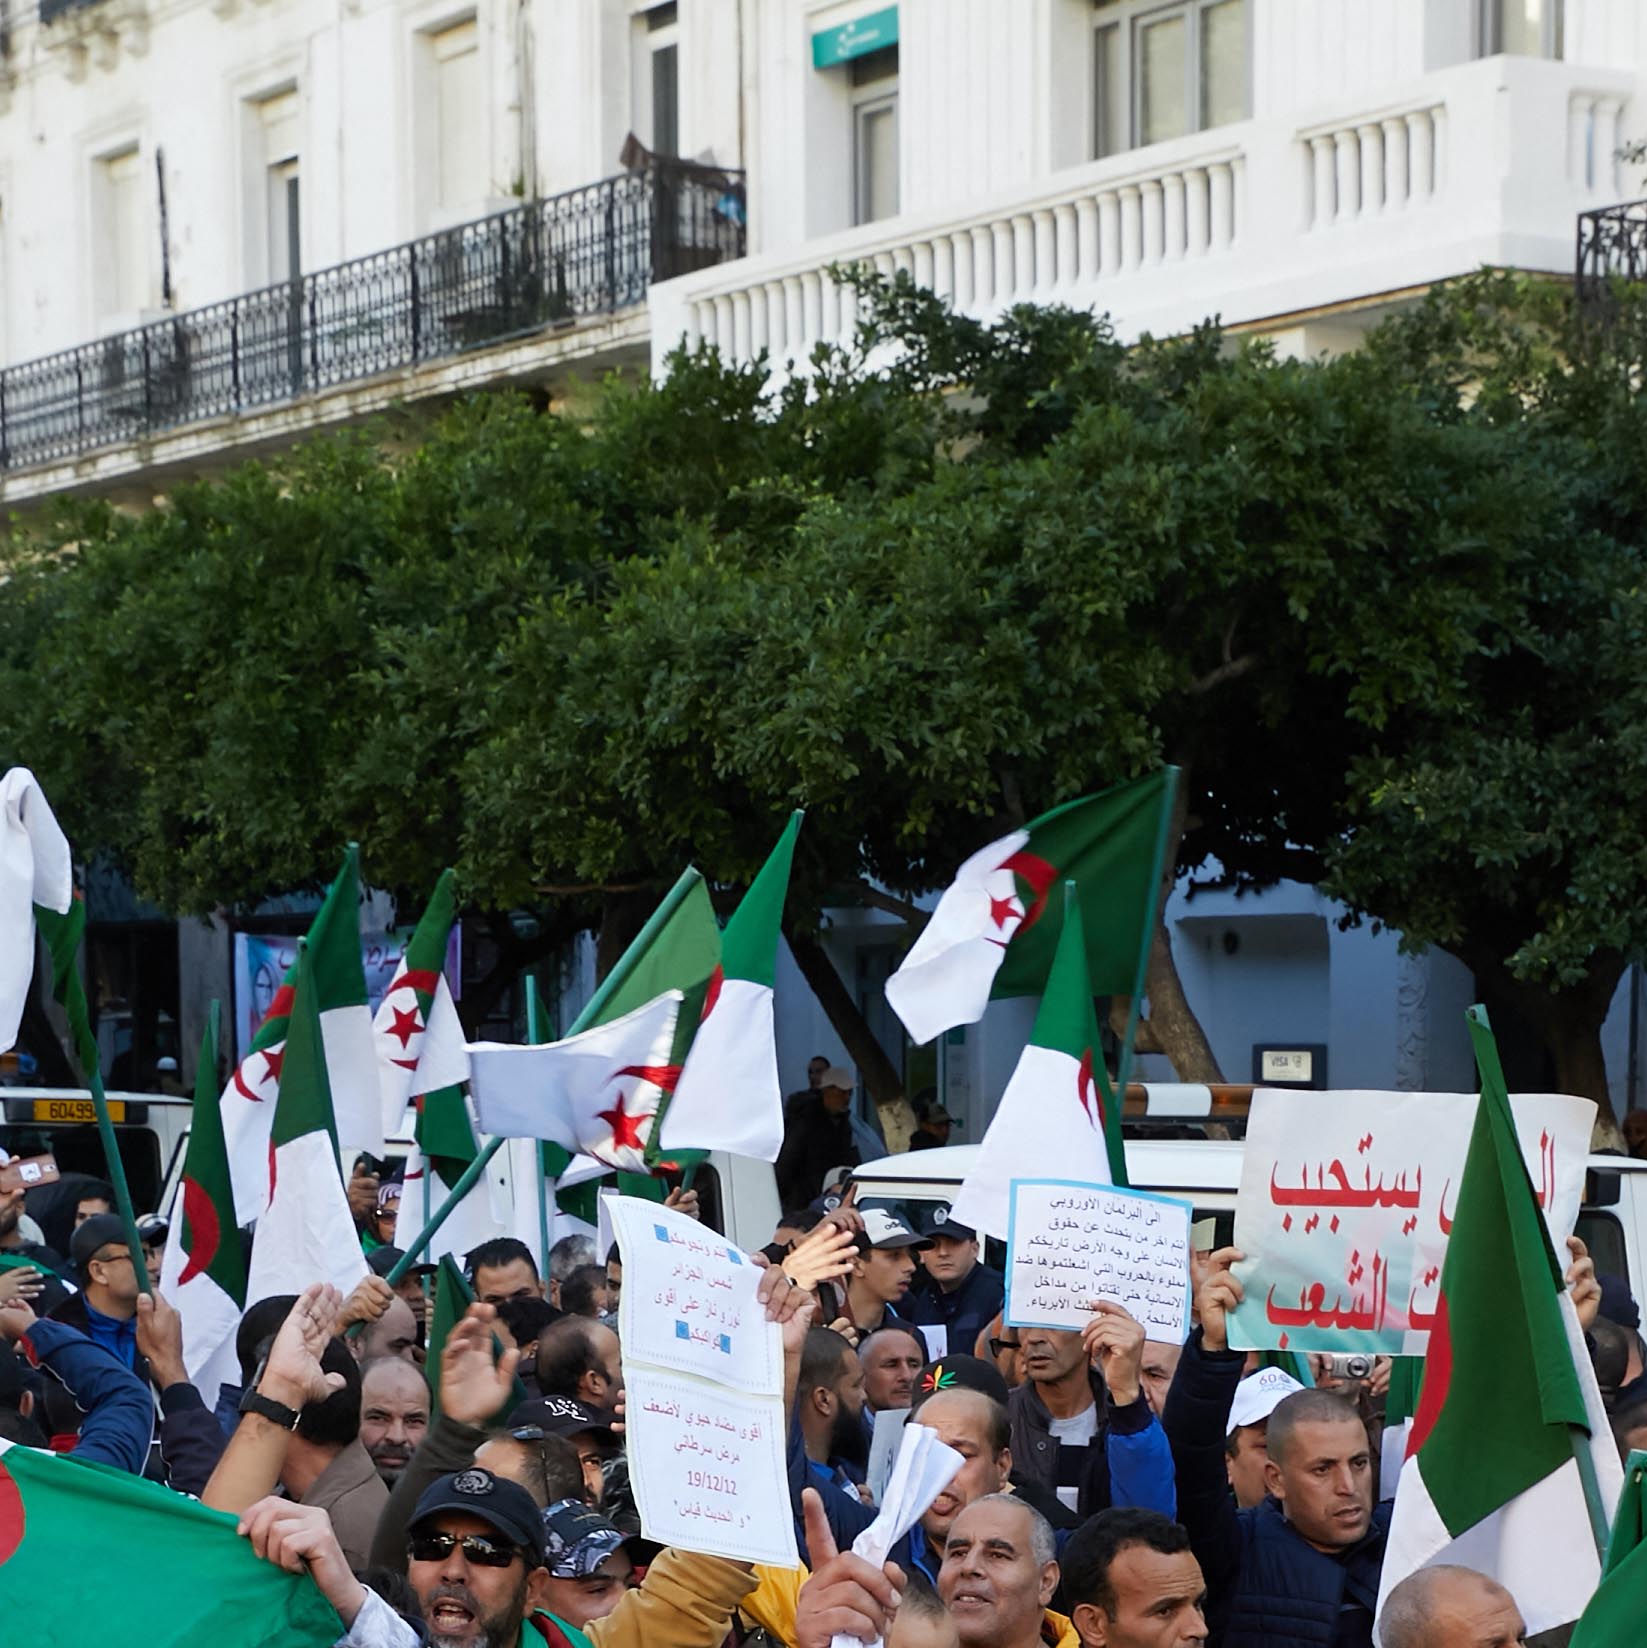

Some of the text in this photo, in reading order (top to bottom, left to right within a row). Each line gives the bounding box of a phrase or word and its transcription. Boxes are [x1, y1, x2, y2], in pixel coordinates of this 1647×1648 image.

[50, 1102, 97, 1119] 60499
[1270, 1131, 1422, 1234] يستجيب
[1104, 1203, 1142, 1219] البرلمان
[1048, 1217, 1079, 1231] حقوق
[1083, 1221, 1099, 1233] عن
[1104, 1223, 1131, 1241] يتحدث
[1136, 1233, 1148, 1244] من
[1015, 1254, 1033, 1265] ضد
[1110, 1247, 1130, 1260] وجه
[1133, 1251, 1150, 1264] على
[1093, 1264, 1114, 1277] التي
[1034, 1275, 1067, 1289] مداخل
[1071, 1282, 1087, 1293] من
[1266, 1249, 1388, 1349] الشعب
[688, 1470, 737, 1496] 19/12/12
